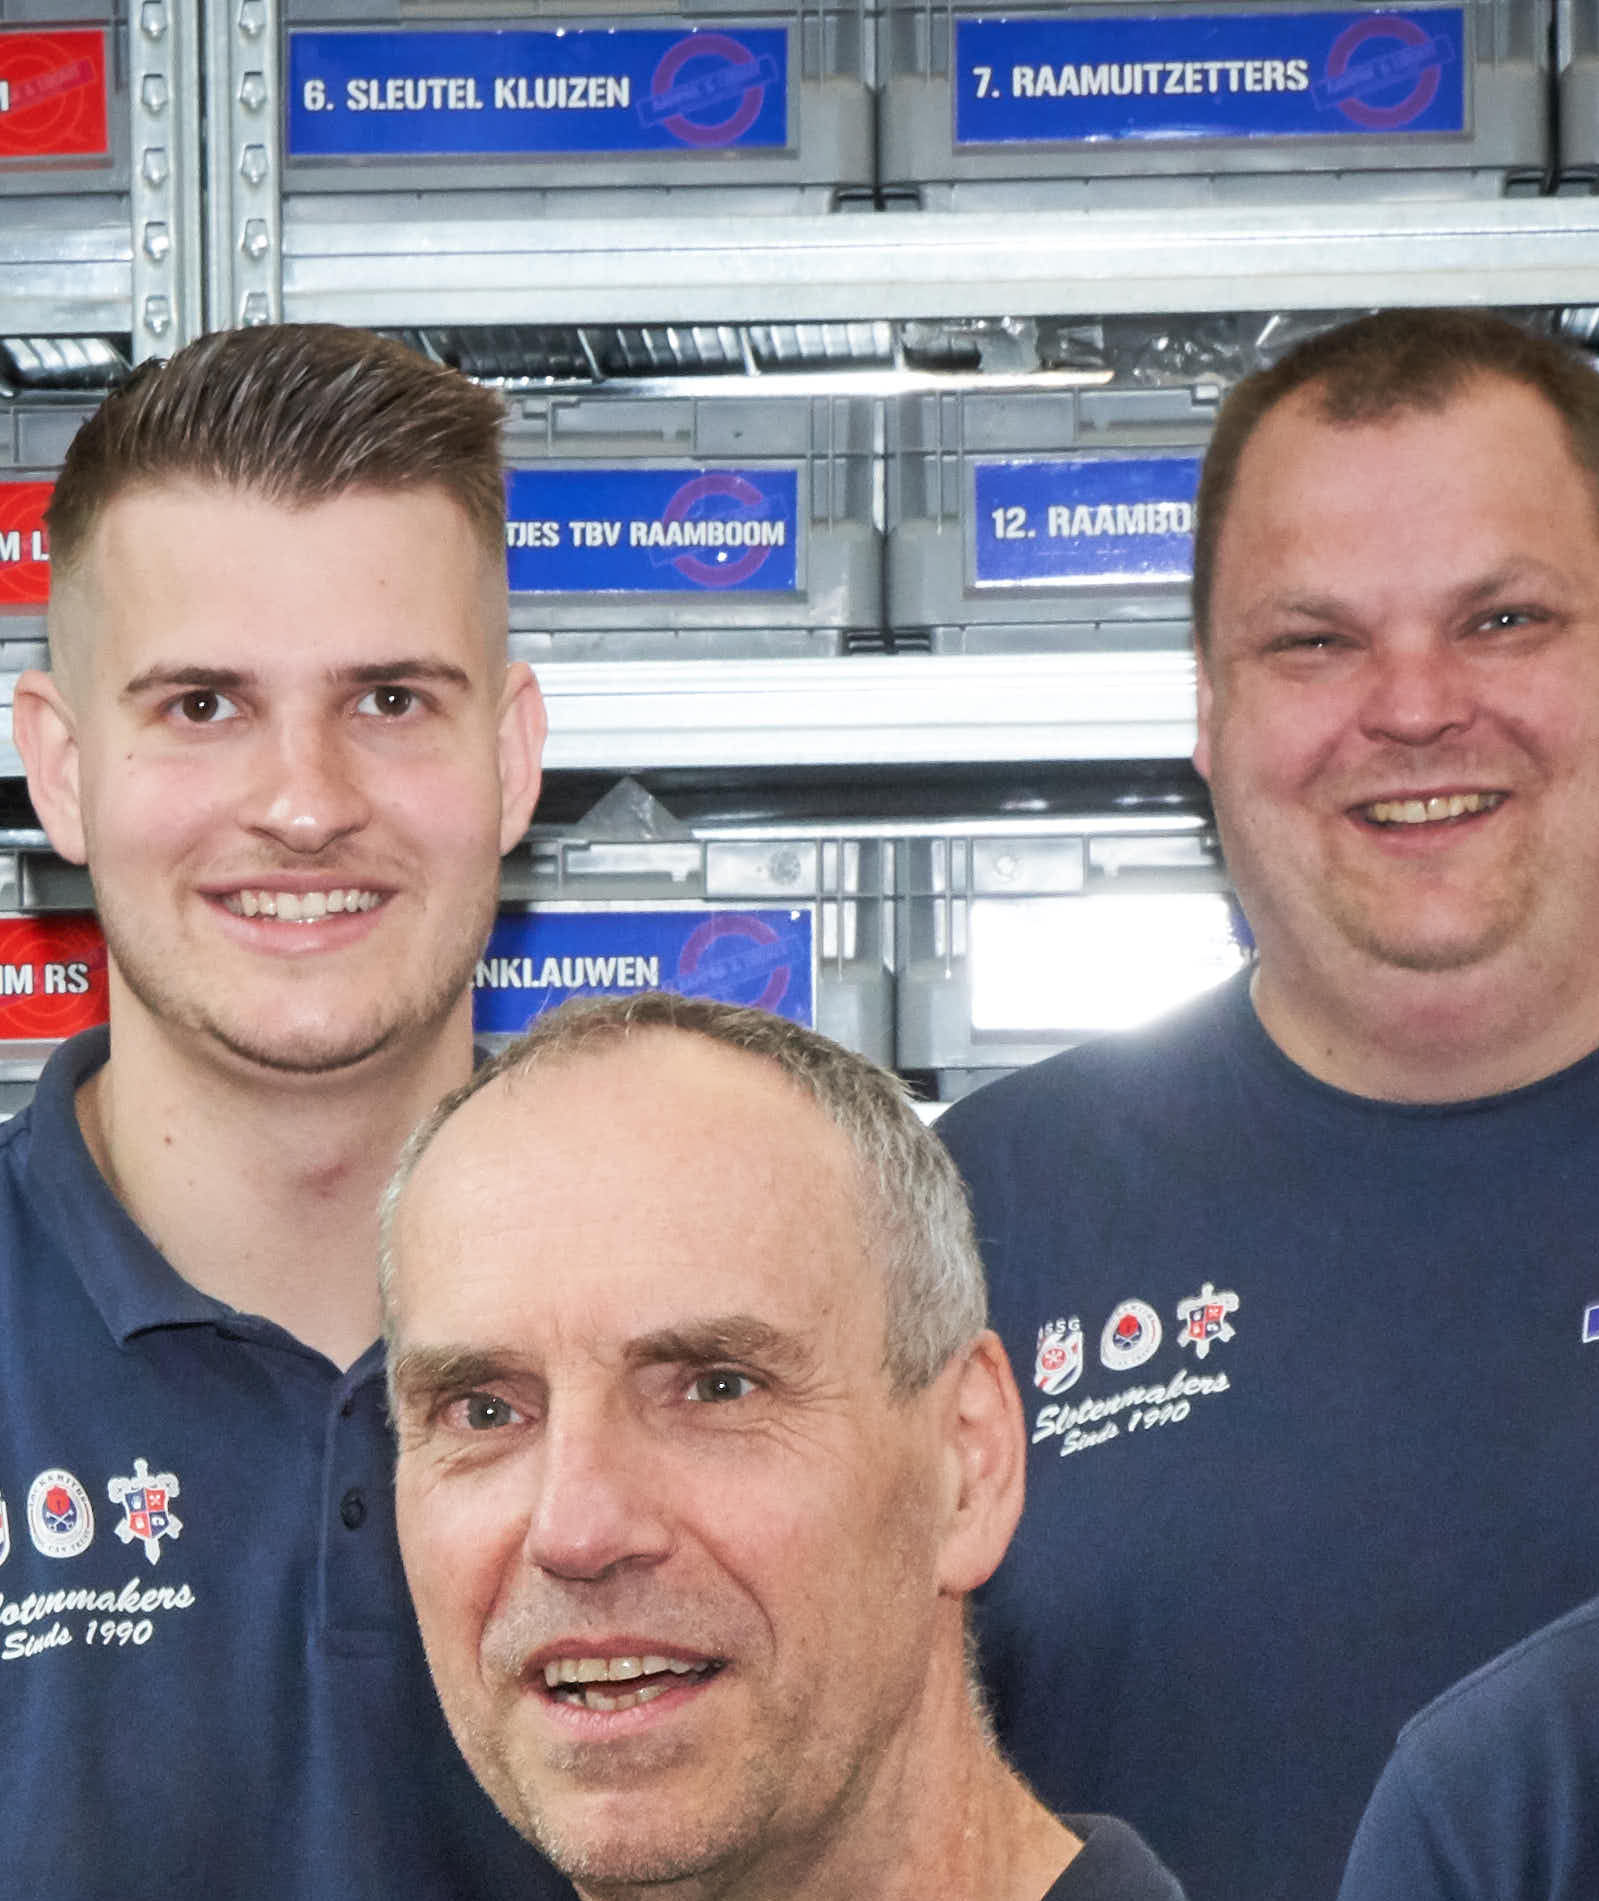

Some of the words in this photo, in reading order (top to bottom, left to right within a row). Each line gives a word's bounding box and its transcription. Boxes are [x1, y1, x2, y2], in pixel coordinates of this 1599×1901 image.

[302, 78, 336, 112] 6.
[345, 76, 485, 112] SLEUTEL
[493, 75, 631, 110] KLUIZEN
[971, 65, 1001, 100] 7.
[1011, 58, 1310, 99] RAAMUITZETTERS
[567, 520, 623, 548] TBV
[628, 518, 787, 550] RAAMBOOM
[990, 505, 1038, 541] 12.
[1046, 501, 1197, 539] RAAMBO
[43, 962, 90, 996] RS
[85, 1618, 153, 1646] 1990
